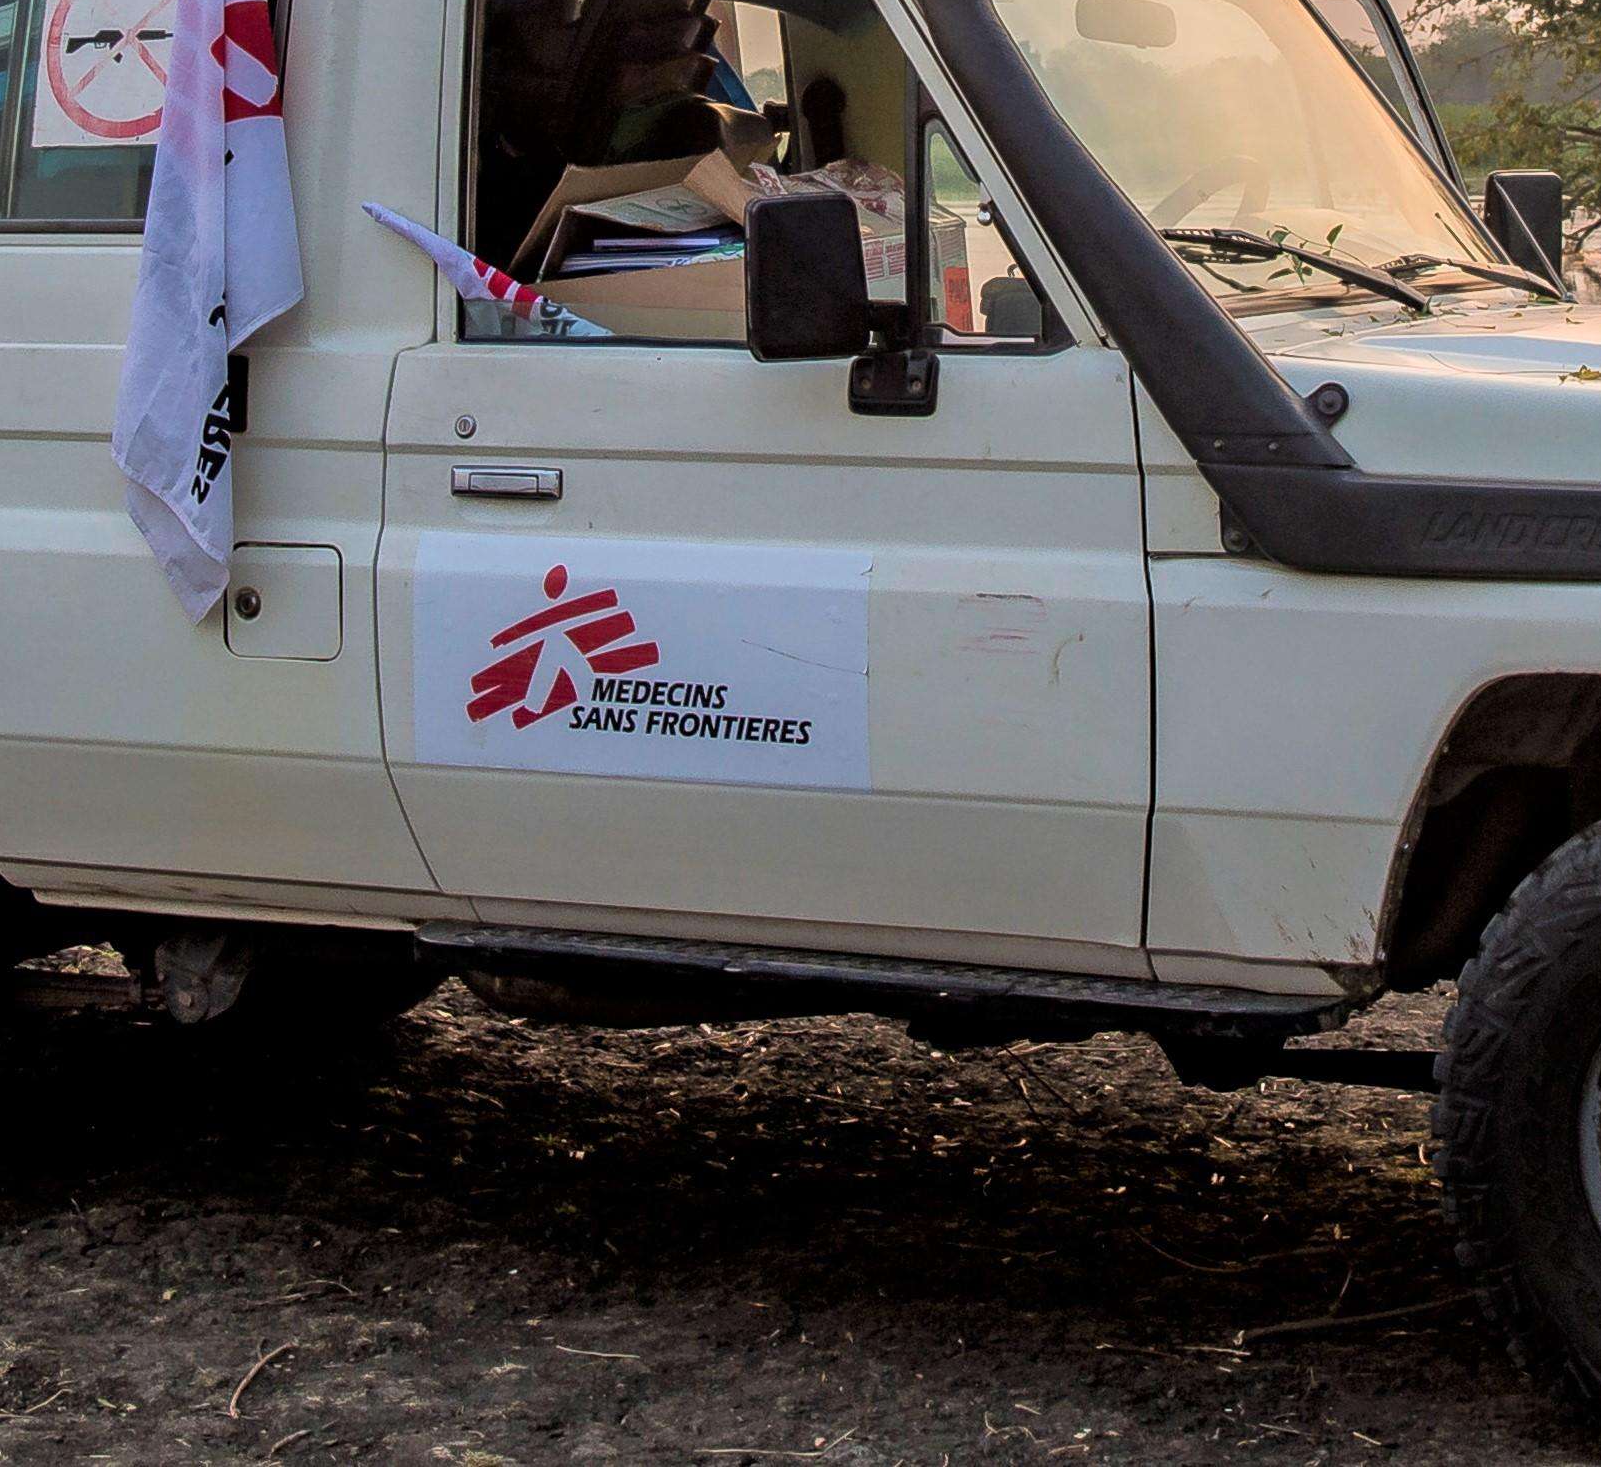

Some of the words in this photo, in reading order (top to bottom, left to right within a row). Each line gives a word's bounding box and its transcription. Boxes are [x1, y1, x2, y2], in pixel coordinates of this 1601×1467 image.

[591, 678, 728, 709] MEDECINS
[569, 705, 639, 733] SANS
[645, 710, 812, 745] FRONTIERES
